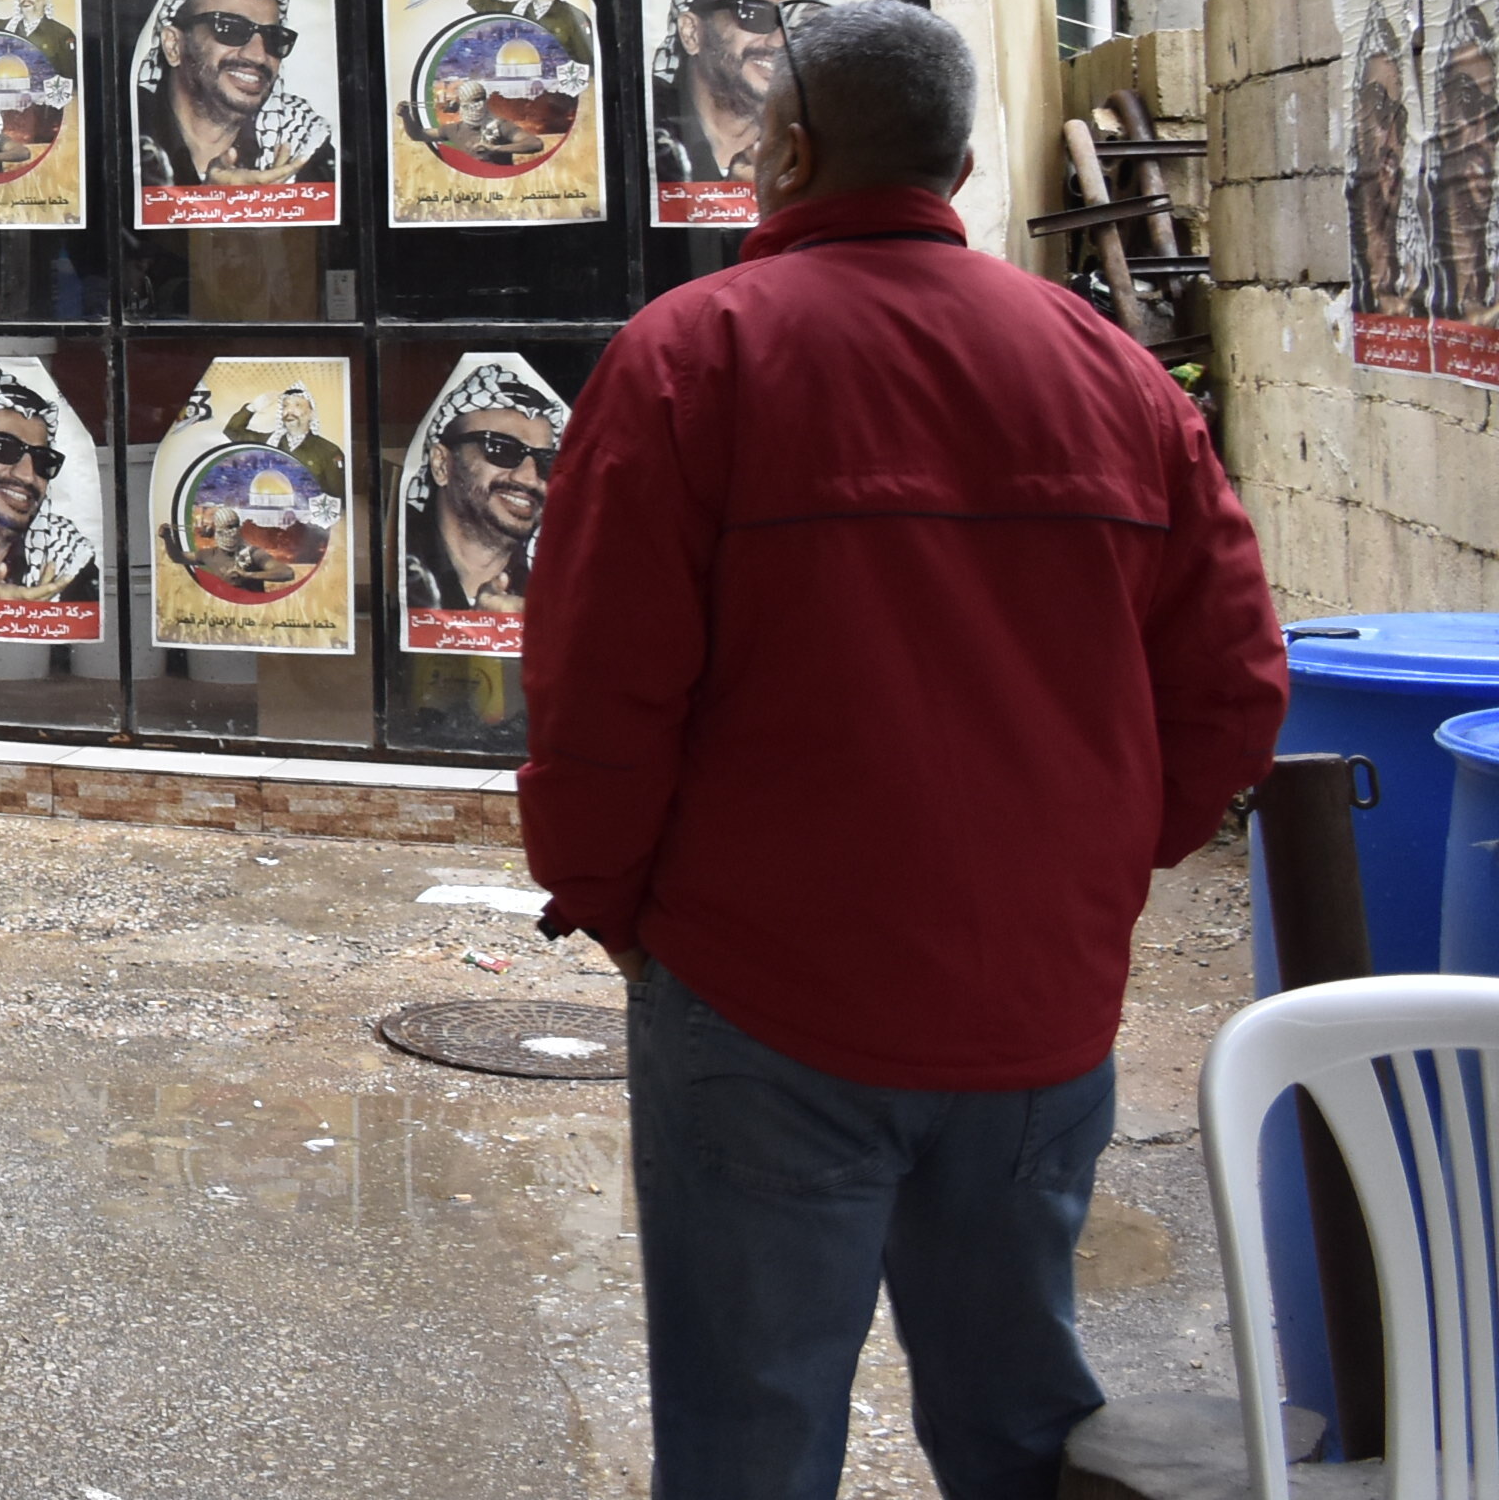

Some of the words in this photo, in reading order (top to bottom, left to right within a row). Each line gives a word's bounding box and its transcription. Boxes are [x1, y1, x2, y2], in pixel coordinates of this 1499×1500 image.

[145, 191, 168, 205] فتح
[176, 190, 226, 205] الفلسطيني
[227, 189, 260, 204] الوطني
[262, 188, 298, 201] التحرير
[300, 187, 330, 200] حركة
[661, 188, 686, 201] فتح
[695, 187, 750, 203] الفلسطيني
[168, 208, 221, 223] الديمقراطي
[221, 207, 274, 222] الإصلاحي
[276, 206, 304, 219] التيار
[687, 206, 746, 222] الديمقراطي
[27, 604, 62, 618] التحرير
[66, 606, 95, 619] حركة
[411, 614, 435, 627] فتح
[444, 616, 495, 630] الفلسطيني
[40, 624, 70, 637] التيار
[436, 633, 490, 648] الديمقراطي
